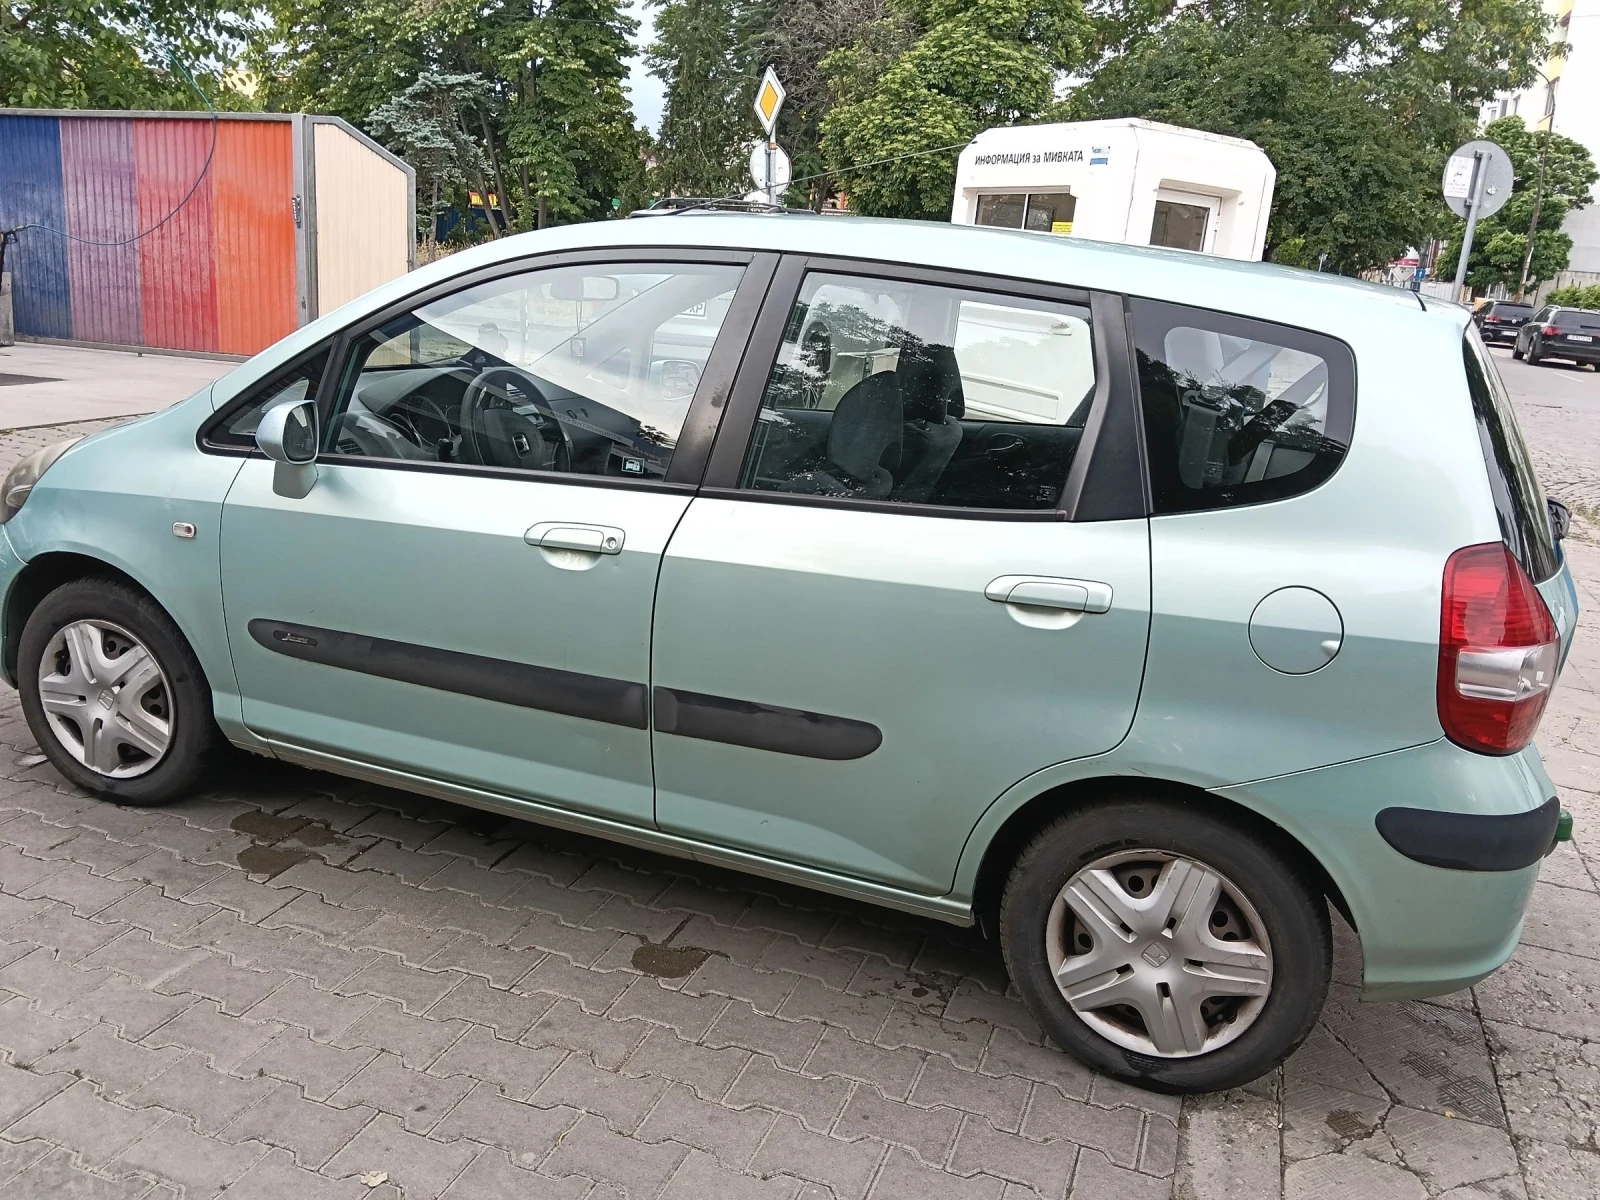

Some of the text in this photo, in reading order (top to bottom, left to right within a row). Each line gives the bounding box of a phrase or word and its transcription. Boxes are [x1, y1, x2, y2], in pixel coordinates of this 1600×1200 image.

[974, 152, 1031, 166] ИНФОРМАЦИЯ
[1032, 154, 1041, 164] за
[1043, 150, 1084, 164] МИВКАТА
